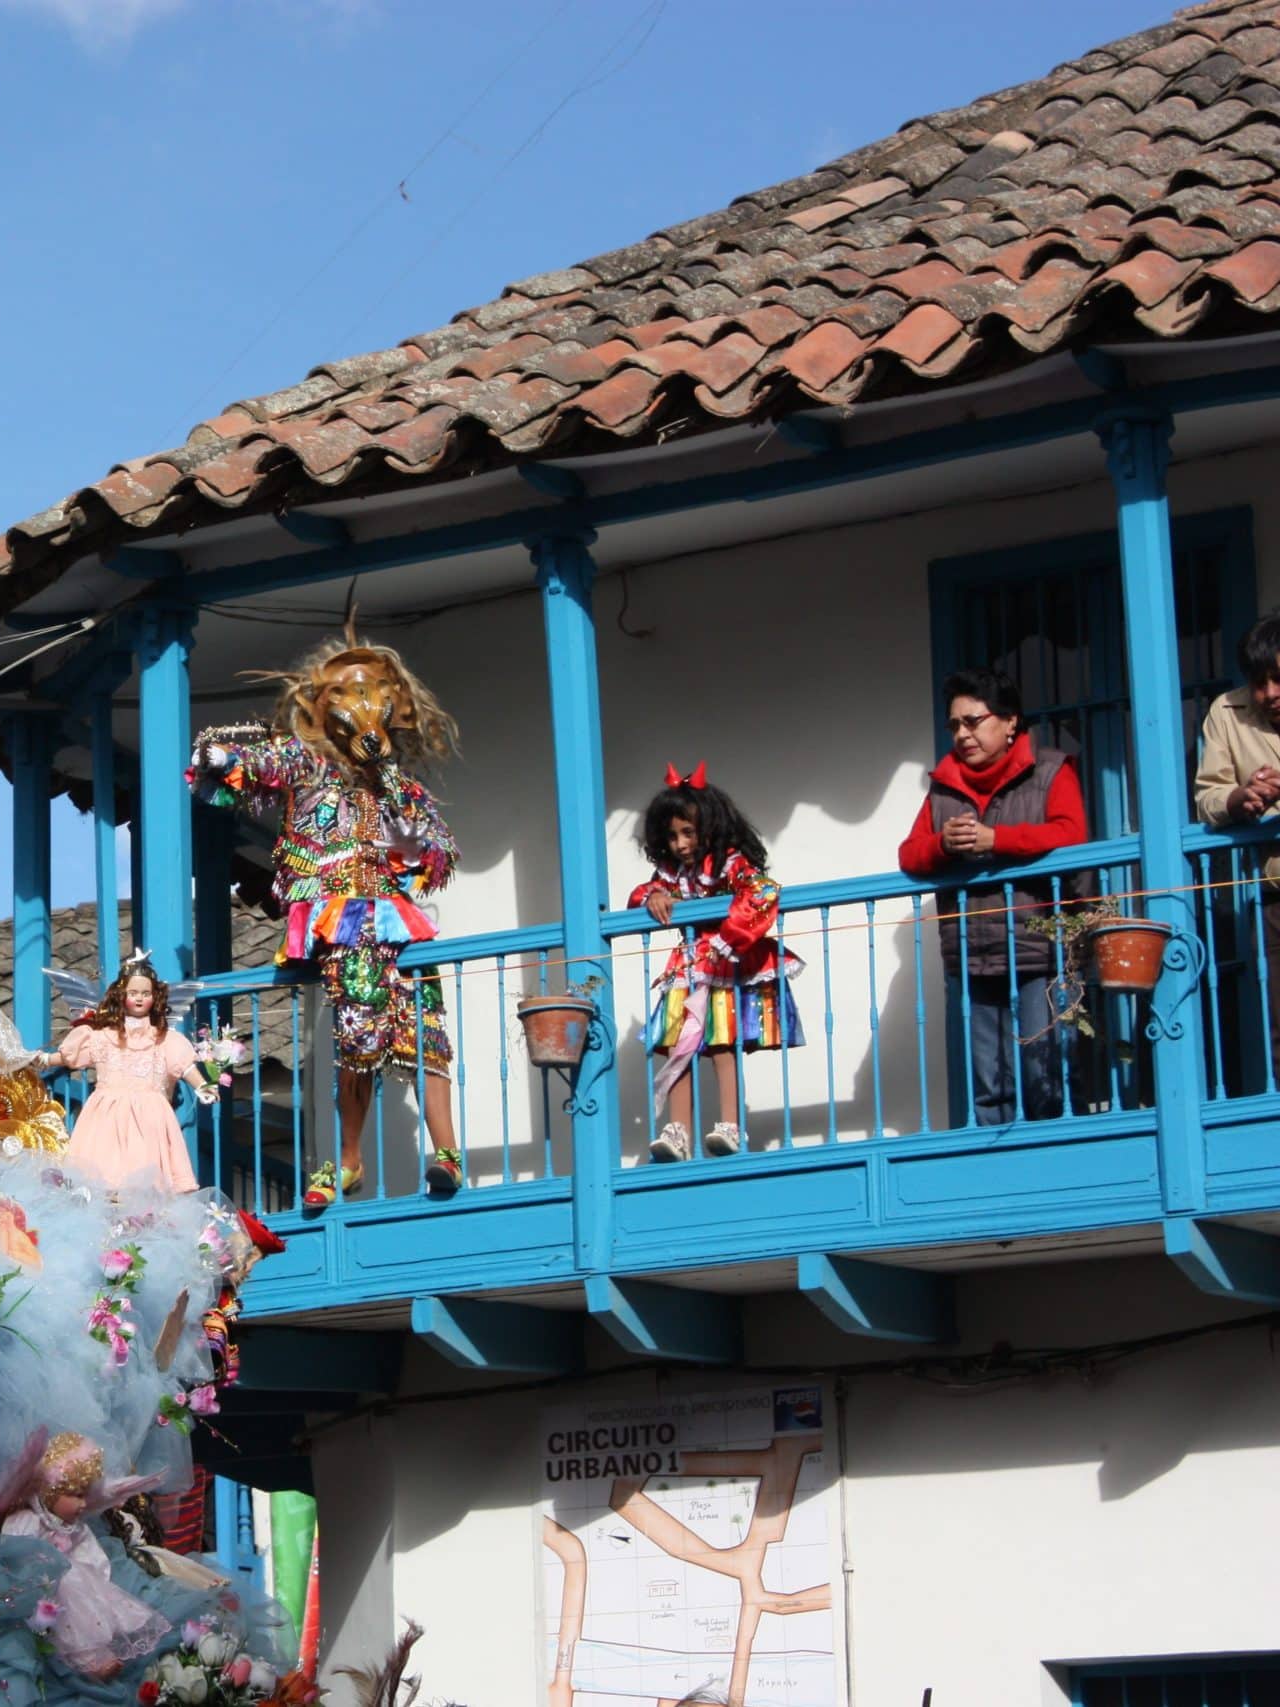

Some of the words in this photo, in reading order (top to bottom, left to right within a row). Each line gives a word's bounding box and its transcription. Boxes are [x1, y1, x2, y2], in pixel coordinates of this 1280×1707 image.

[776, 1389, 819, 1406] PEPSI
[547, 1423, 677, 1456] CIRCUITO
[546, 1450, 662, 1482] URBANO
[667, 1449, 680, 1473] 1
